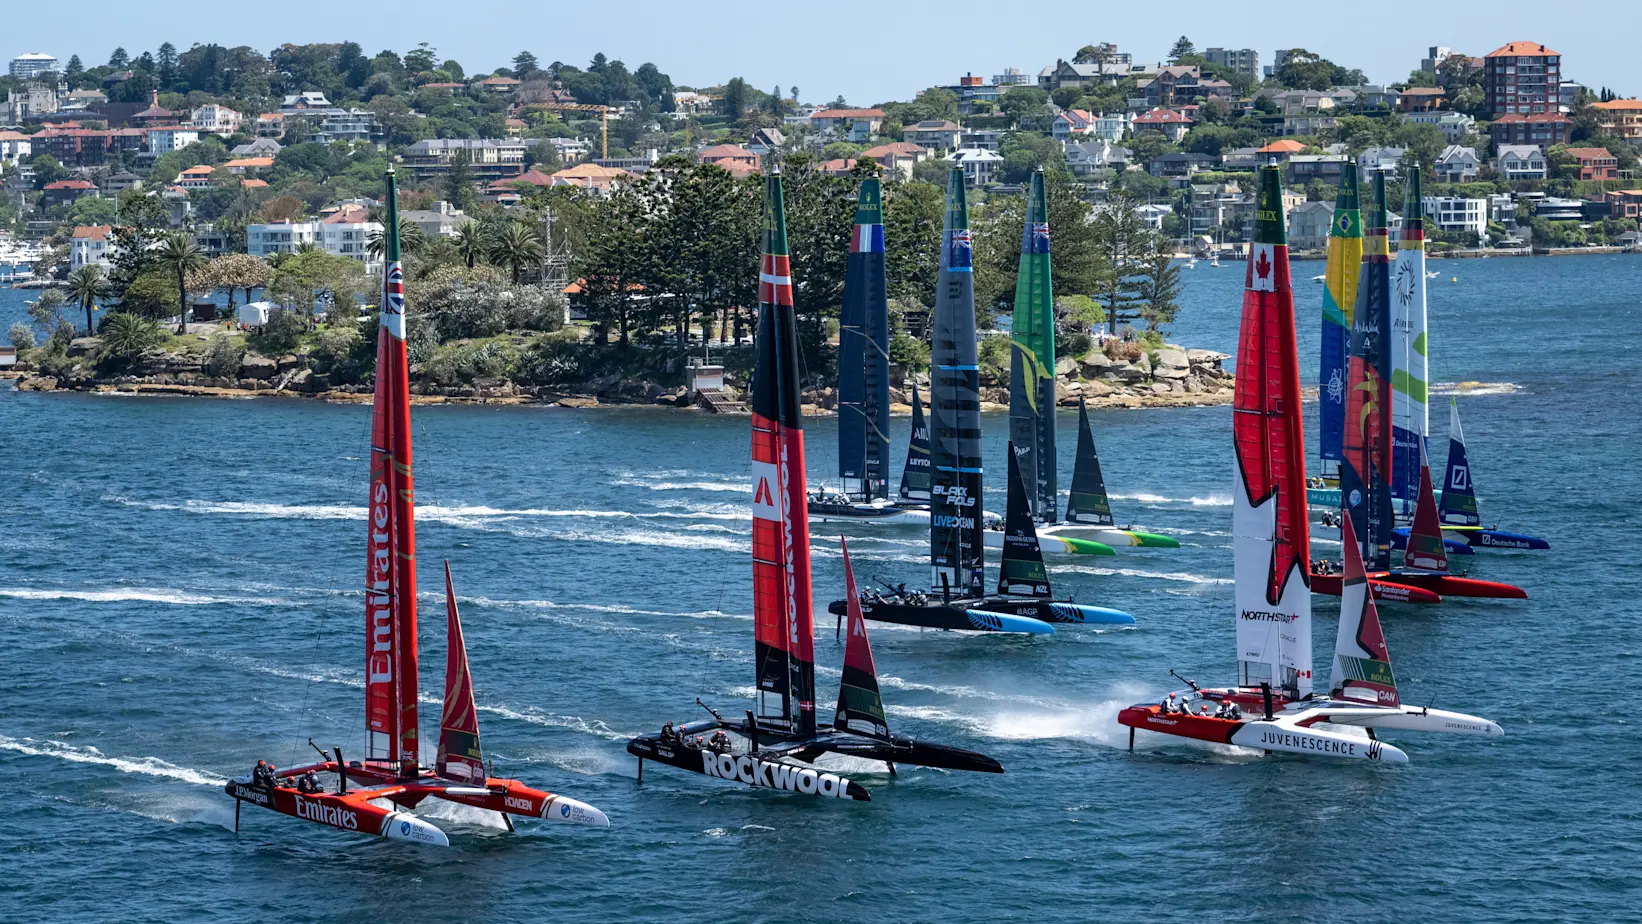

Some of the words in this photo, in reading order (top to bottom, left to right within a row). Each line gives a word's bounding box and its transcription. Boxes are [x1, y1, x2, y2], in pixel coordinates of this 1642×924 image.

[932, 485, 968, 497] BLACK
[780, 444, 798, 644] ROCKWOOL
[1491, 539, 1516, 547] Deutsche
[369, 482, 393, 686] Emirates
[1035, 585, 1048, 594] NZL
[1381, 585, 1410, 595] Santander
[1022, 608, 1038, 616] AGP
[1370, 673, 1392, 684] ROLEX
[1378, 690, 1396, 702] CAN
[1445, 722, 1482, 731] JUVENESCENCE
[1261, 731, 1355, 756] JUVENESCENCE
[701, 749, 854, 800] ROCKWOOL
[504, 796, 532, 811] HOWDEN
[294, 794, 358, 830] Emirates
[572, 805, 585, 814] low
[572, 813, 595, 823] carbon
[412, 822, 425, 832] low
[412, 831, 435, 843] carbon
